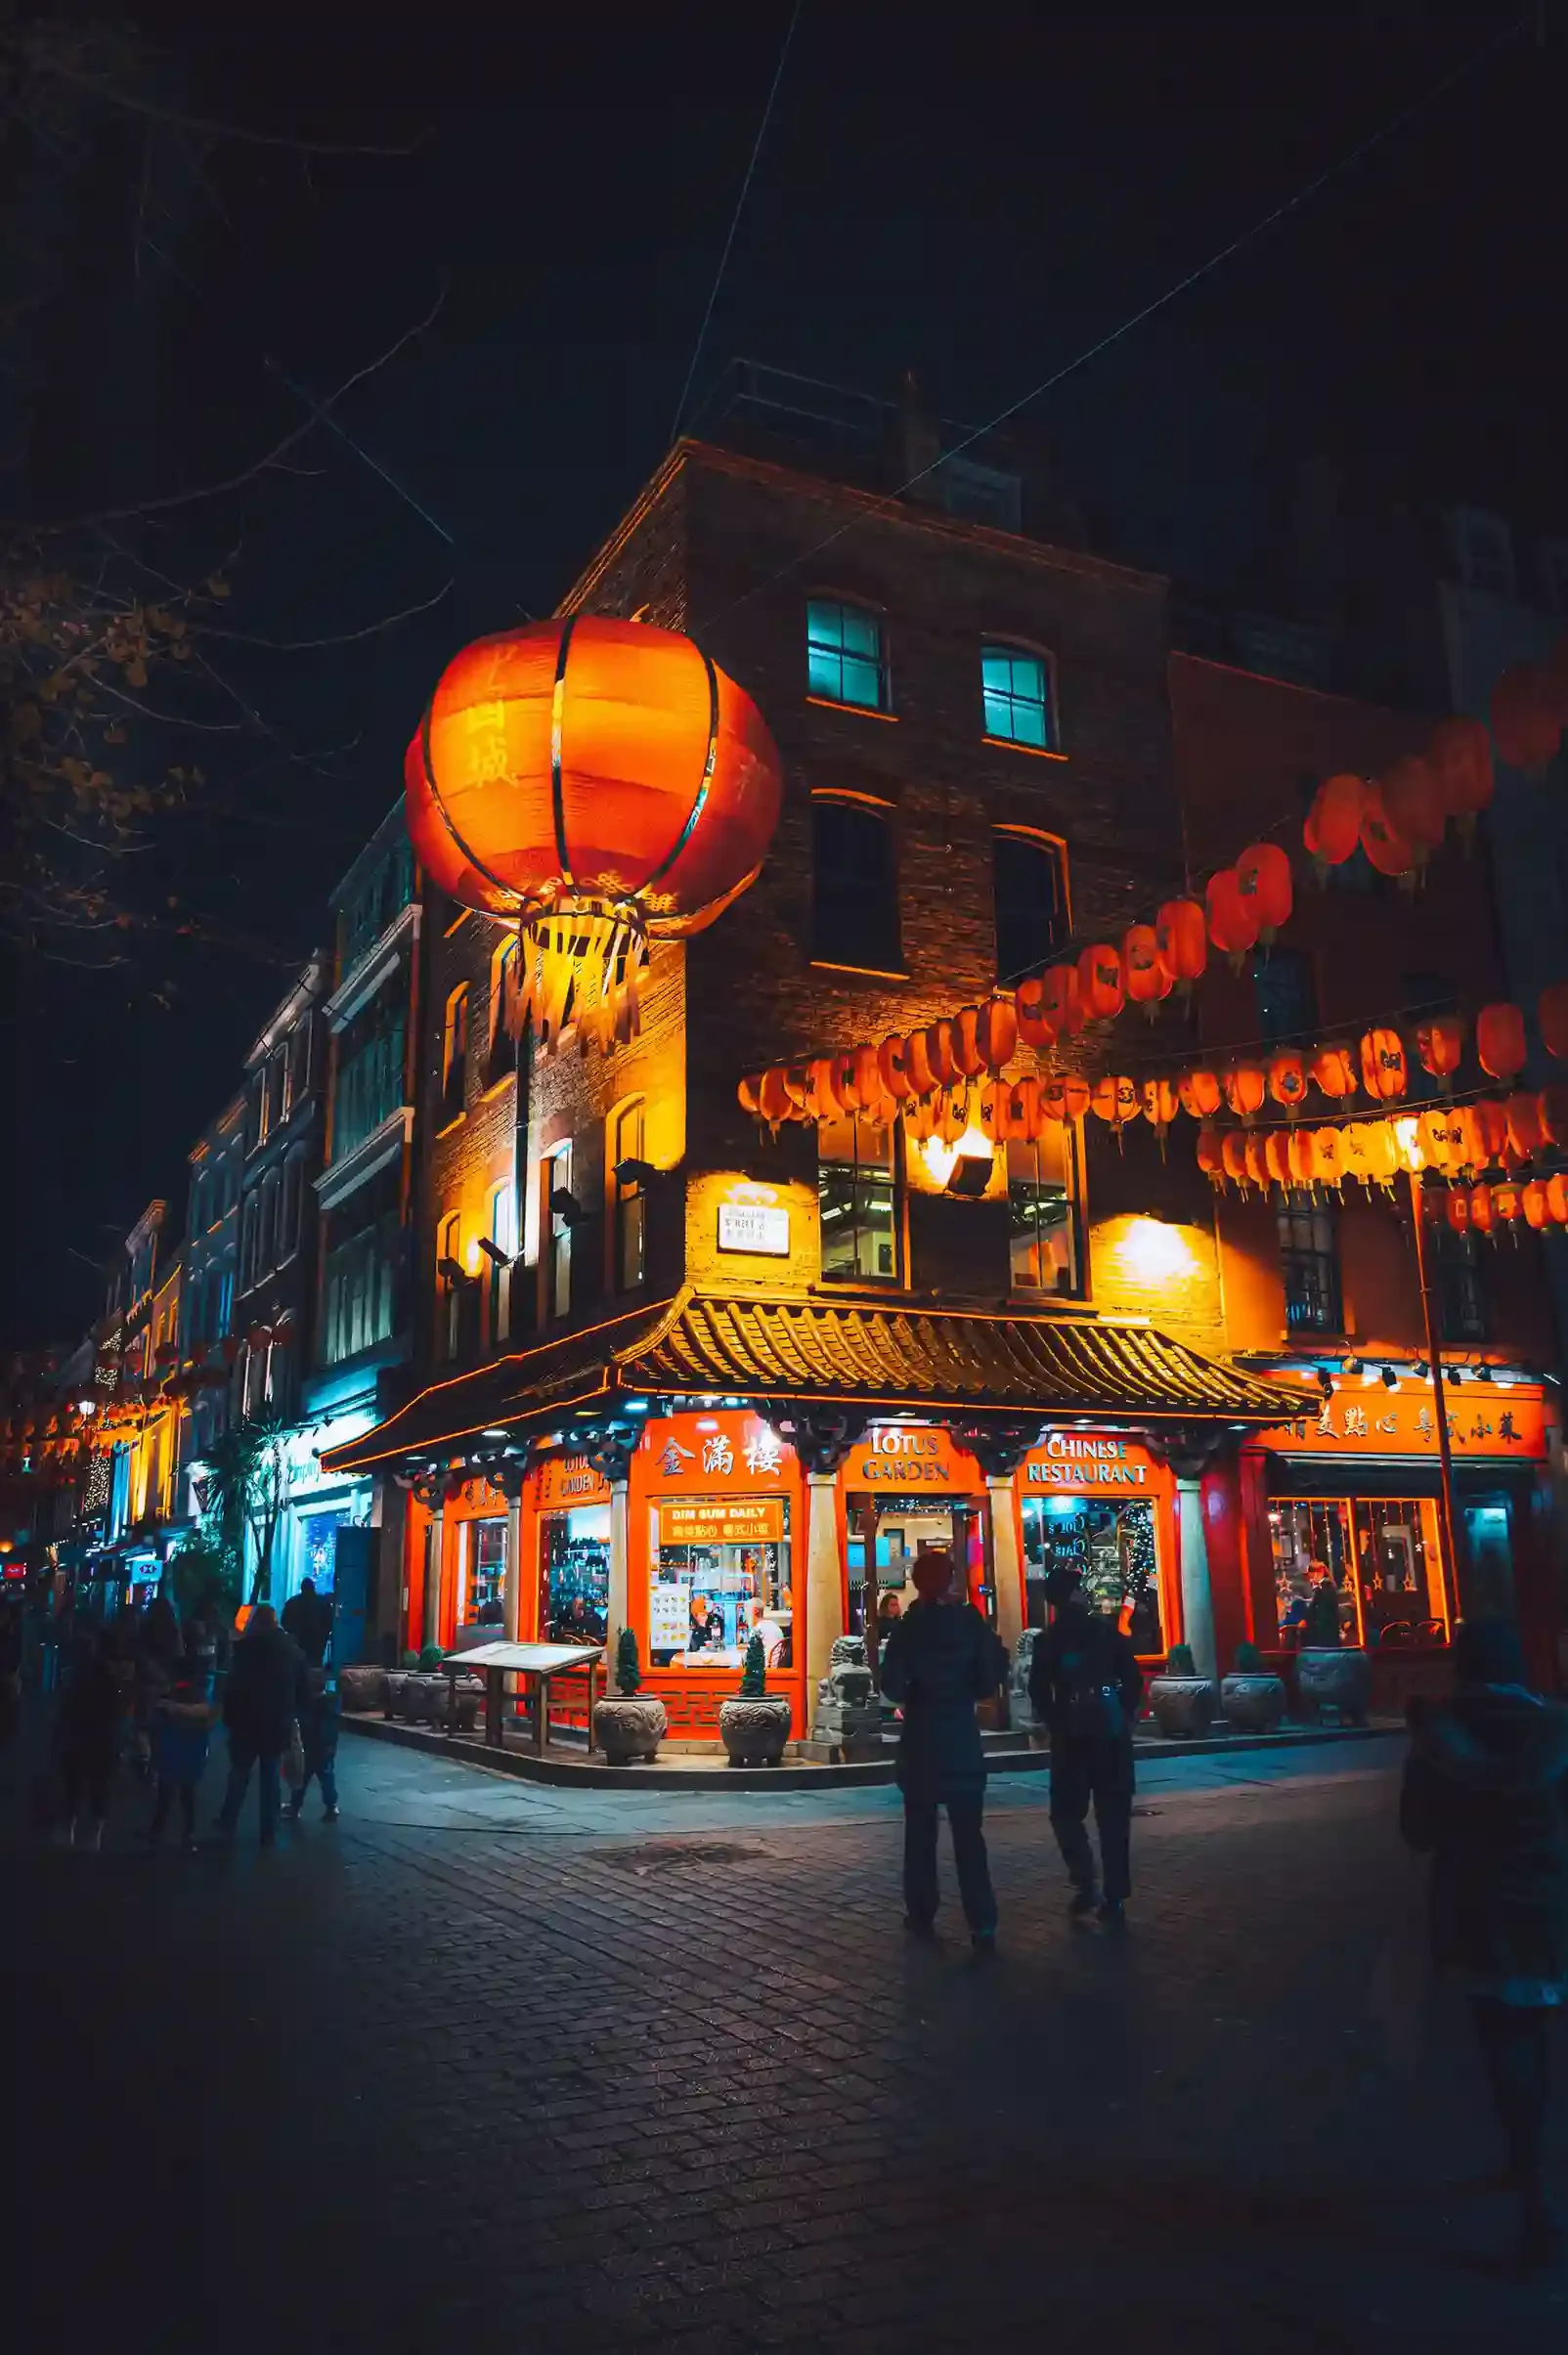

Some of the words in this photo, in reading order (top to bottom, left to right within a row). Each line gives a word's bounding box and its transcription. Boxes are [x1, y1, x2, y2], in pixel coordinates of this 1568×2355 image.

[871, 1432, 939, 1455] LOTUS
[1046, 1436, 1127, 1460] CHINESE
[655, 1434, 782, 1477] 金滿樓
[862, 1461, 950, 1481] GARDEN
[1027, 1461, 1148, 1485] RESTAURANT
[672, 1508, 696, 1520] DIM
[699, 1507, 726, 1520] SUM
[729, 1506, 766, 1519] DAILY
